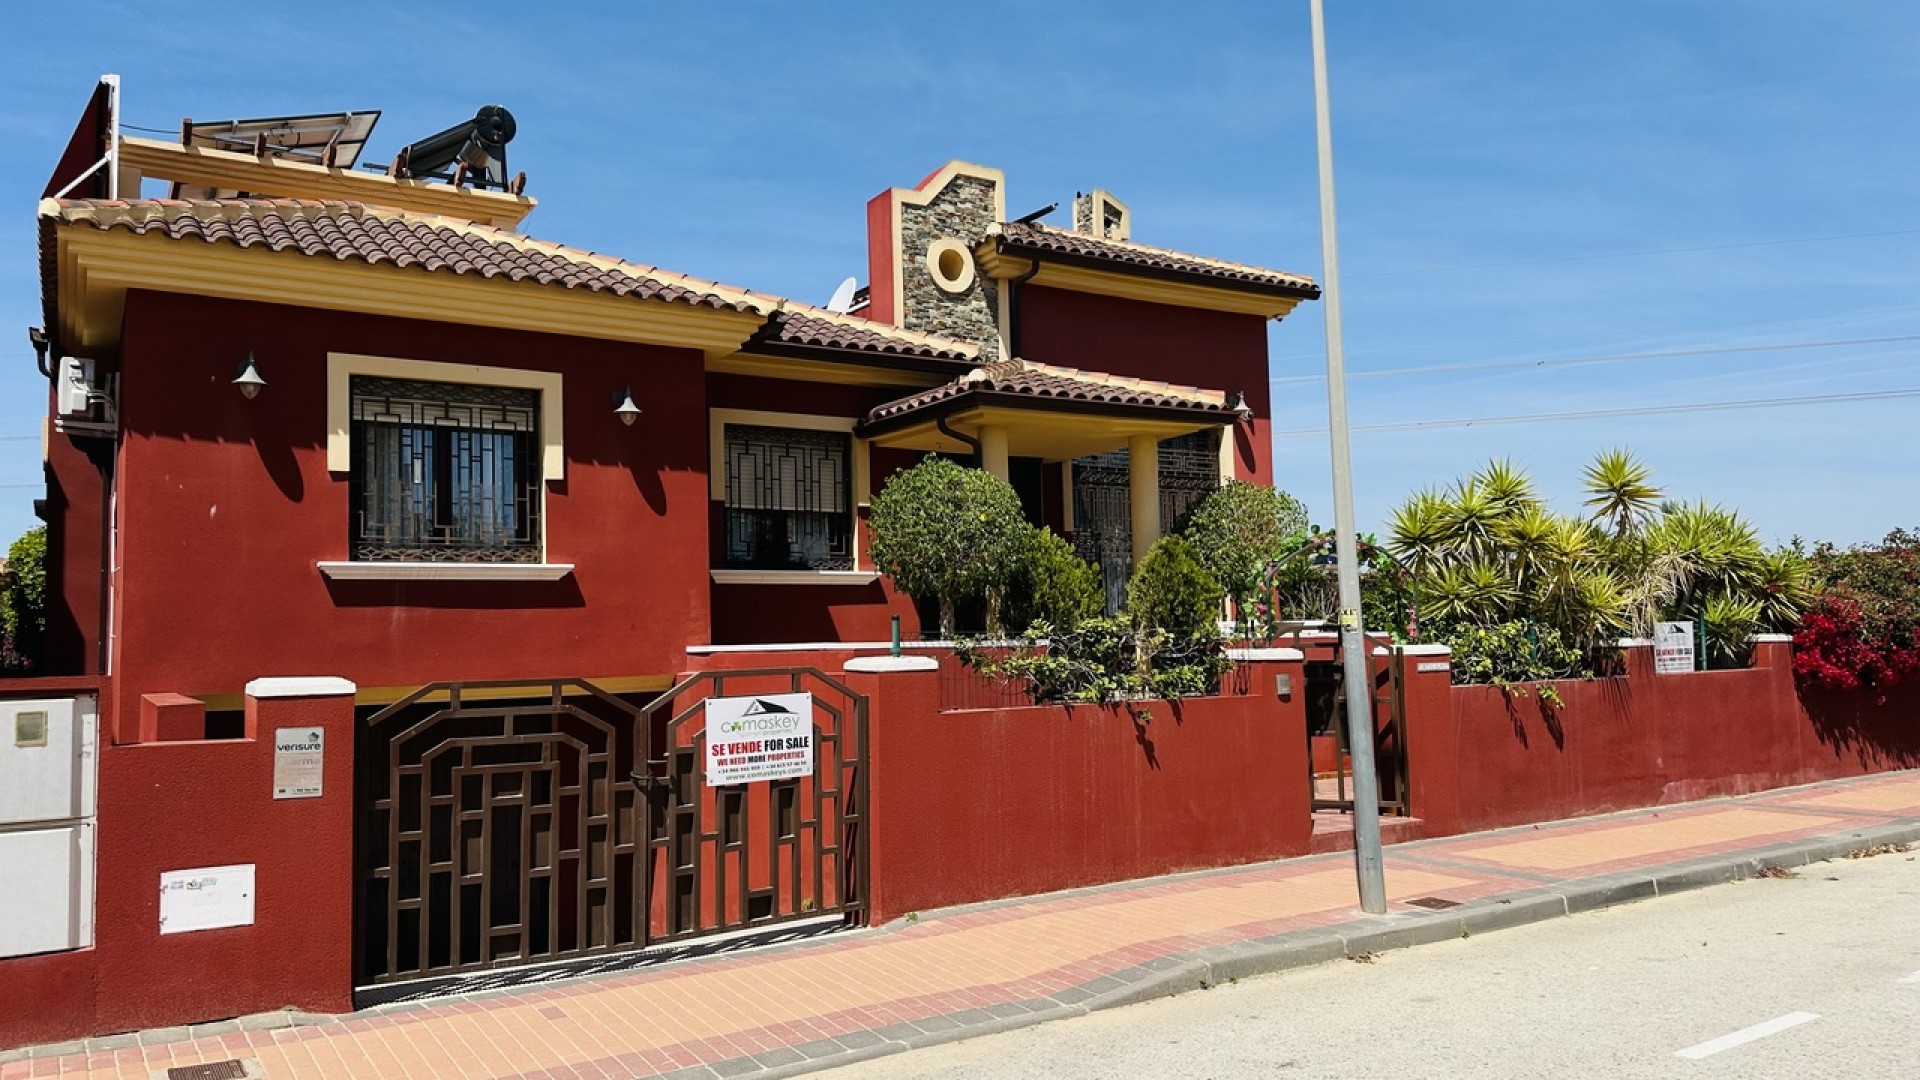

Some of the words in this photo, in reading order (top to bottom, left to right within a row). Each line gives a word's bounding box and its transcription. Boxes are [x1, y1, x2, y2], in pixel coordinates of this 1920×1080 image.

[277, 743, 321, 751] verisure
[712, 744, 725, 756] SE
[727, 741, 762, 755] VENDE
[764, 739, 783, 752] FOR
[786, 736, 809, 750] SALE
[747, 755, 765, 763] MORE
